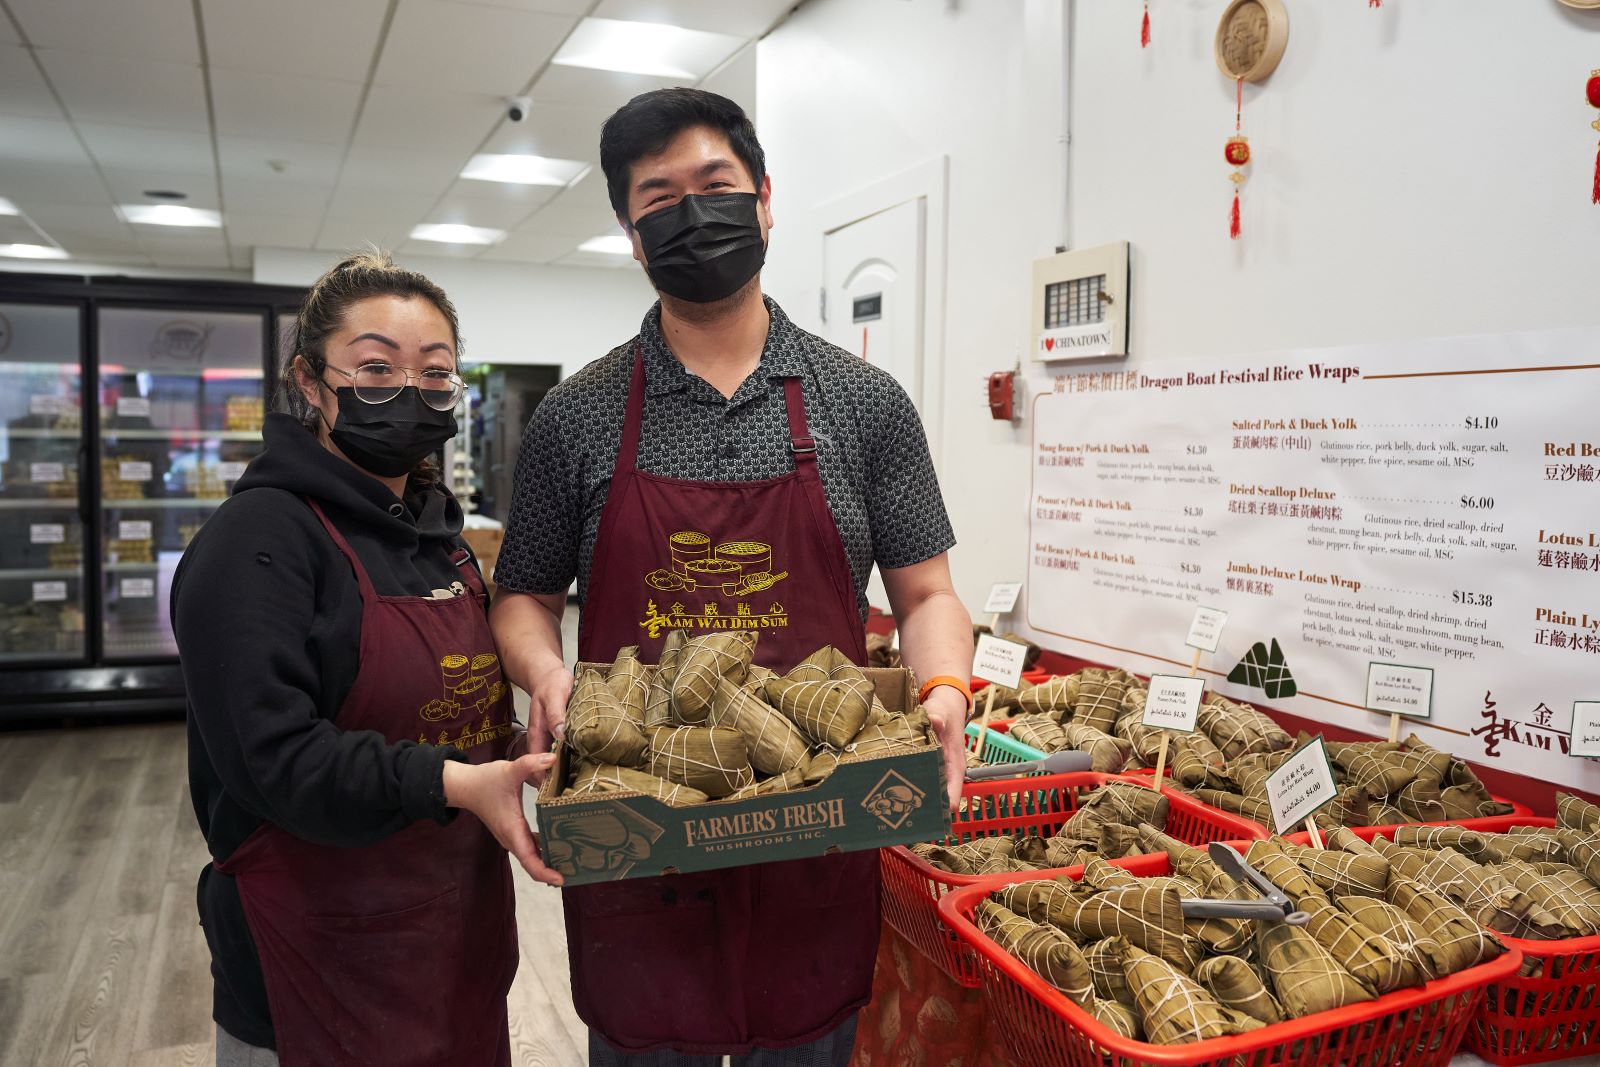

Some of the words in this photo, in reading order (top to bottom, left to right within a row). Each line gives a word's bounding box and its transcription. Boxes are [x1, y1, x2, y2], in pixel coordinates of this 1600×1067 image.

[1140, 375, 1183, 389] Dragon
[1186, 371, 1215, 386] Boat
[1220, 367, 1270, 384] Festival
[1273, 365, 1304, 381] Rice
[1309, 362, 1360, 384] Wraps
[1232, 420, 1261, 430] Salted
[1263, 419, 1285, 430] Pork
[1288, 419, 1296, 430] &
[1300, 418, 1328, 430] Duck
[1331, 418, 1357, 430] Yolk
[1464, 416, 1499, 430] $4.10
[1085, 443, 1101, 453] Pork
[1110, 443, 1130, 453] Duck
[1131, 443, 1150, 454] Yolk
[1320, 440, 1354, 450] Glutinous
[1375, 441, 1392, 453] pork
[1394, 441, 1414, 454] belly,
[1416, 441, 1436, 451] duck
[1439, 441, 1459, 454] yolk,
[1461, 444, 1488, 454] sugar,
[1490, 442, 1509, 453] salt,
[1544, 443, 1576, 456] Red
[1321, 456, 1338, 464] white
[1340, 457, 1366, 467] pepper,
[1368, 456, 1381, 465] five
[1383, 456, 1406, 468] spice,
[1407, 458, 1435, 466] sesame
[1436, 457, 1451, 467] oil,
[1453, 457, 1474, 467] MSG
[1070, 498, 1086, 507] Pork
[1095, 500, 1113, 510] Duck
[1116, 501, 1132, 511] Yolk
[1229, 484, 1255, 495] Dried
[1257, 485, 1297, 501] Scallop
[1299, 487, 1336, 500] Deluxe
[1460, 494, 1494, 510] $6.00
[1364, 513, 1401, 526] Glutinous
[1404, 516, 1421, 527] rice,
[1423, 517, 1445, 529] dried
[1447, 520, 1478, 534] scallop,
[1480, 522, 1504, 533] dried
[1307, 523, 1337, 534] chestnut,
[1339, 528, 1360, 538] mung
[1362, 527, 1382, 538] bean,
[1384, 531, 1401, 542] pork
[1404, 531, 1424, 545] belly,
[1426, 534, 1446, 544] duck
[1449, 535, 1468, 549] yolk,
[1470, 538, 1488, 549] salt,
[1490, 541, 1518, 553] sugar,
[1538, 529, 1584, 546] Lotus
[1326, 541, 1351, 552] pepper,
[1353, 541, 1366, 550] five
[1367, 542, 1388, 555] spice,
[1389, 547, 1417, 557] sesame
[1418, 548, 1432, 558] oil,
[1434, 549, 1454, 560] MSG
[1075, 548, 1091, 559] Pork
[1101, 552, 1118, 562] Duck
[1121, 554, 1136, 565] Yolk
[1180, 562, 1201, 575] $4.30
[1226, 561, 1258, 575] Jumbo
[1260, 565, 1296, 580] Deluxe
[1299, 570, 1328, 584] Lotus
[1330, 574, 1361, 592] Wrap
[1452, 590, 1493, 608] $15.38
[660, 613, 694, 628] KAM
[696, 616, 727, 629] WAI
[730, 617, 759, 629] DIM
[760, 615, 788, 628] SUM
[1304, 593, 1336, 607] Glutinous
[1337, 599, 1354, 609] rice,
[1355, 600, 1376, 612] dried
[1378, 604, 1406, 619] scallop,
[1407, 608, 1429, 620] dried
[1431, 612, 1462, 628] shrimp,
[1464, 617, 1487, 630] dried
[1535, 607, 1577, 626] Plain
[1304, 607, 1333, 620] chestnut,
[1335, 611, 1353, 622] lotus
[1354, 615, 1373, 626] seed,
[1375, 618, 1404, 631] shiitake
[1406, 624, 1452, 640] mushroom,
[1454, 633, 1478, 646] mung
[1481, 635, 1505, 649] bean,
[1302, 621, 1317, 632] pork
[1319, 623, 1337, 636] belly,
[1338, 625, 1356, 637] duck
[1358, 629, 1377, 641] yolk,
[1378, 634, 1394, 645] salt,
[1395, 638, 1418, 650] sugar,
[1420, 641, 1442, 653] white
[1444, 646, 1475, 660] pepper,
[1315, 636, 1335, 647] spice,
[1336, 640, 1361, 651] sesame
[1362, 645, 1375, 655] oil,
[1377, 646, 1396, 658] MSG
[1531, 702, 1554, 728] 金
[1502, 718, 1552, 751] KAM
[1305, 782, 1321, 798] $4.00
[593, 808, 615, 816] FRESH
[782, 798, 847, 830] FRESH
[705, 835, 793, 853] MUSHROOMS
[799, 831, 826, 842] INC.
